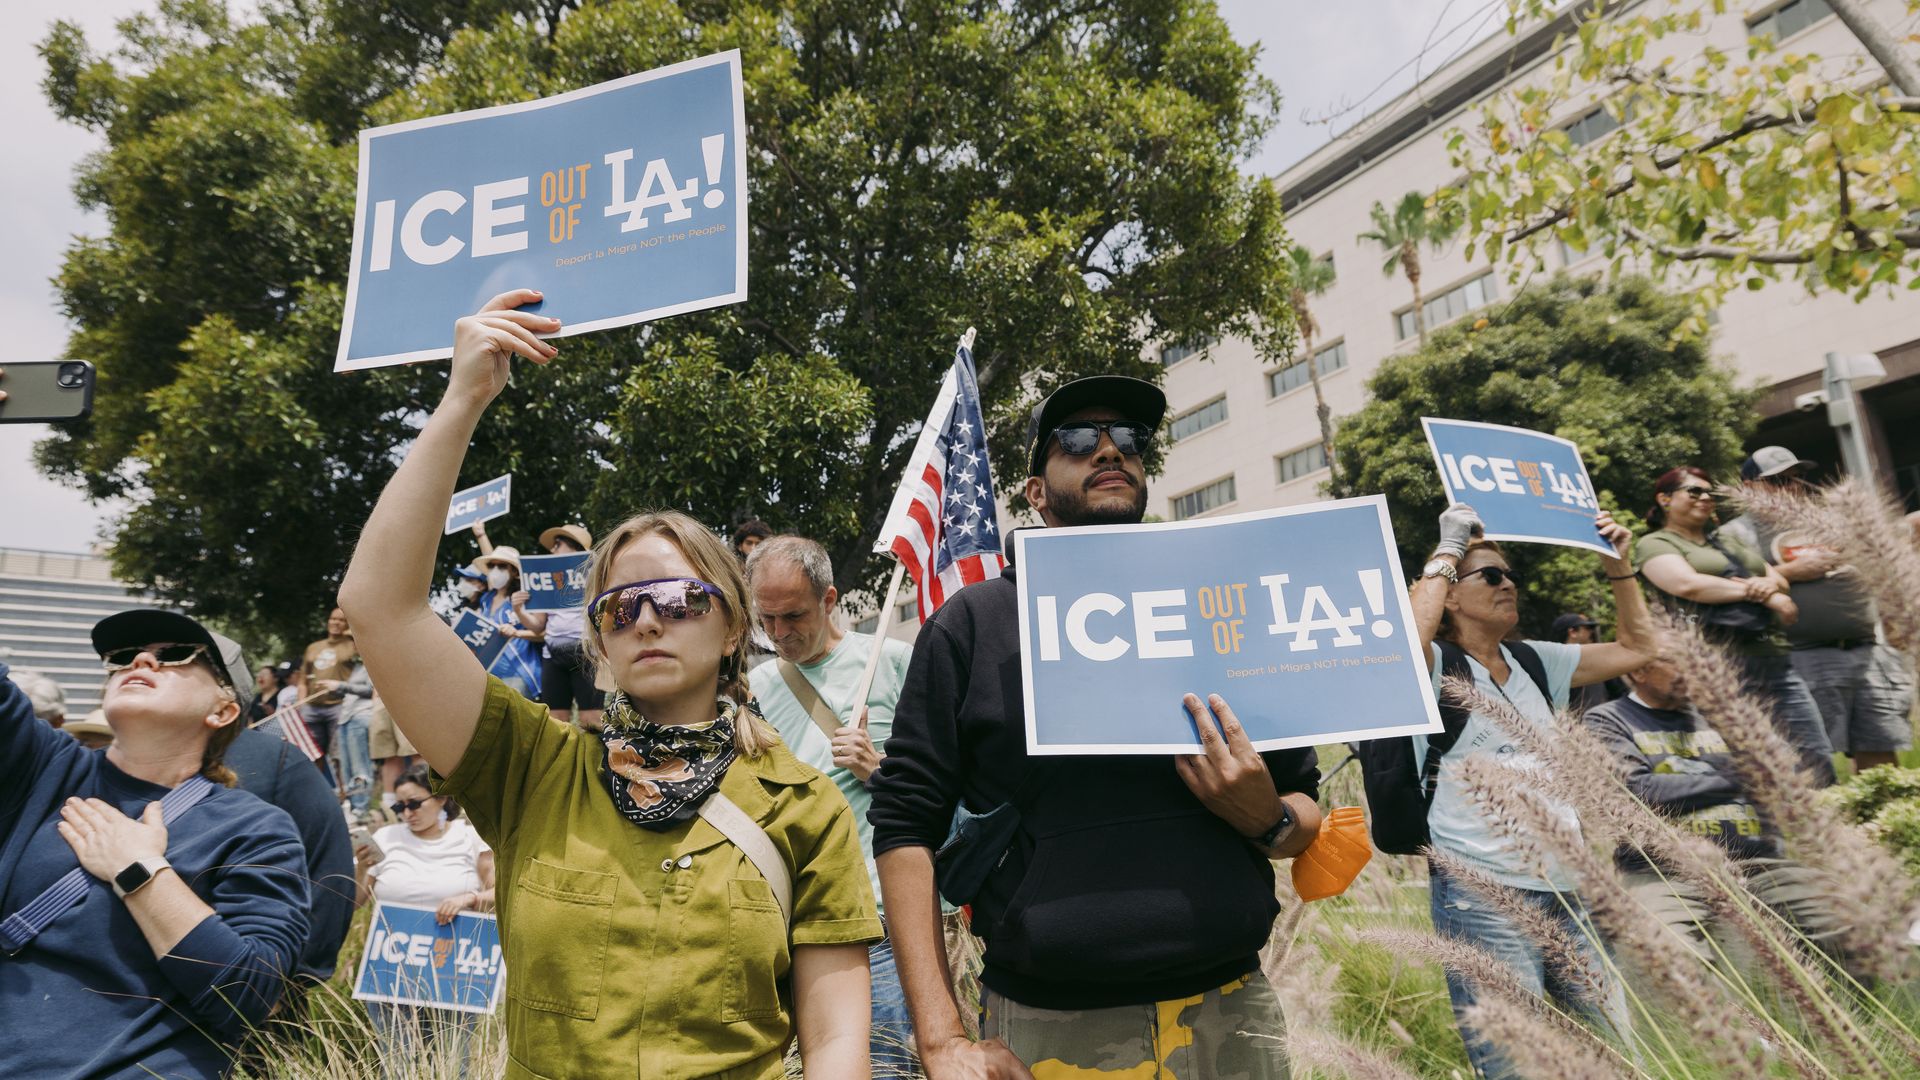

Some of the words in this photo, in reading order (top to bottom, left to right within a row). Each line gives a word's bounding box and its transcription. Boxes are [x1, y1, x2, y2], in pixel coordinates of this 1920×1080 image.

[540, 162, 592, 208] OUT
[604, 133, 725, 233] LA!
[369, 176, 529, 273] ICE
[548, 203, 582, 244] OF
[555, 252, 593, 268] Deport
[595, 250, 605, 258] la
[607, 243, 637, 256] Migra
[640, 235, 665, 249] NOT
[667, 232, 685, 243] the
[688, 223, 727, 238] People
[1442, 453, 1526, 495] ICE
[1540, 461, 1596, 510] LA!
[450, 498, 478, 518] ICE
[523, 571, 554, 591] ICE
[565, 568, 587, 590] LA
[1198, 583, 1248, 620] OUT
[1036, 588, 1195, 661] ICE
[1259, 568, 1394, 652] LA!
[1211, 619, 1246, 655] OF
[1226, 667, 1265, 679] Deport
[1267, 665, 1277, 674] la
[1280, 662, 1311, 673] Migra
[1313, 658, 1338, 670] NOT
[1342, 658, 1360, 667] the
[1363, 653, 1402, 665] People
[1471, 728, 1492, 748] THE
[369, 929, 434, 967] ICE
[453, 937, 502, 976] LA!
